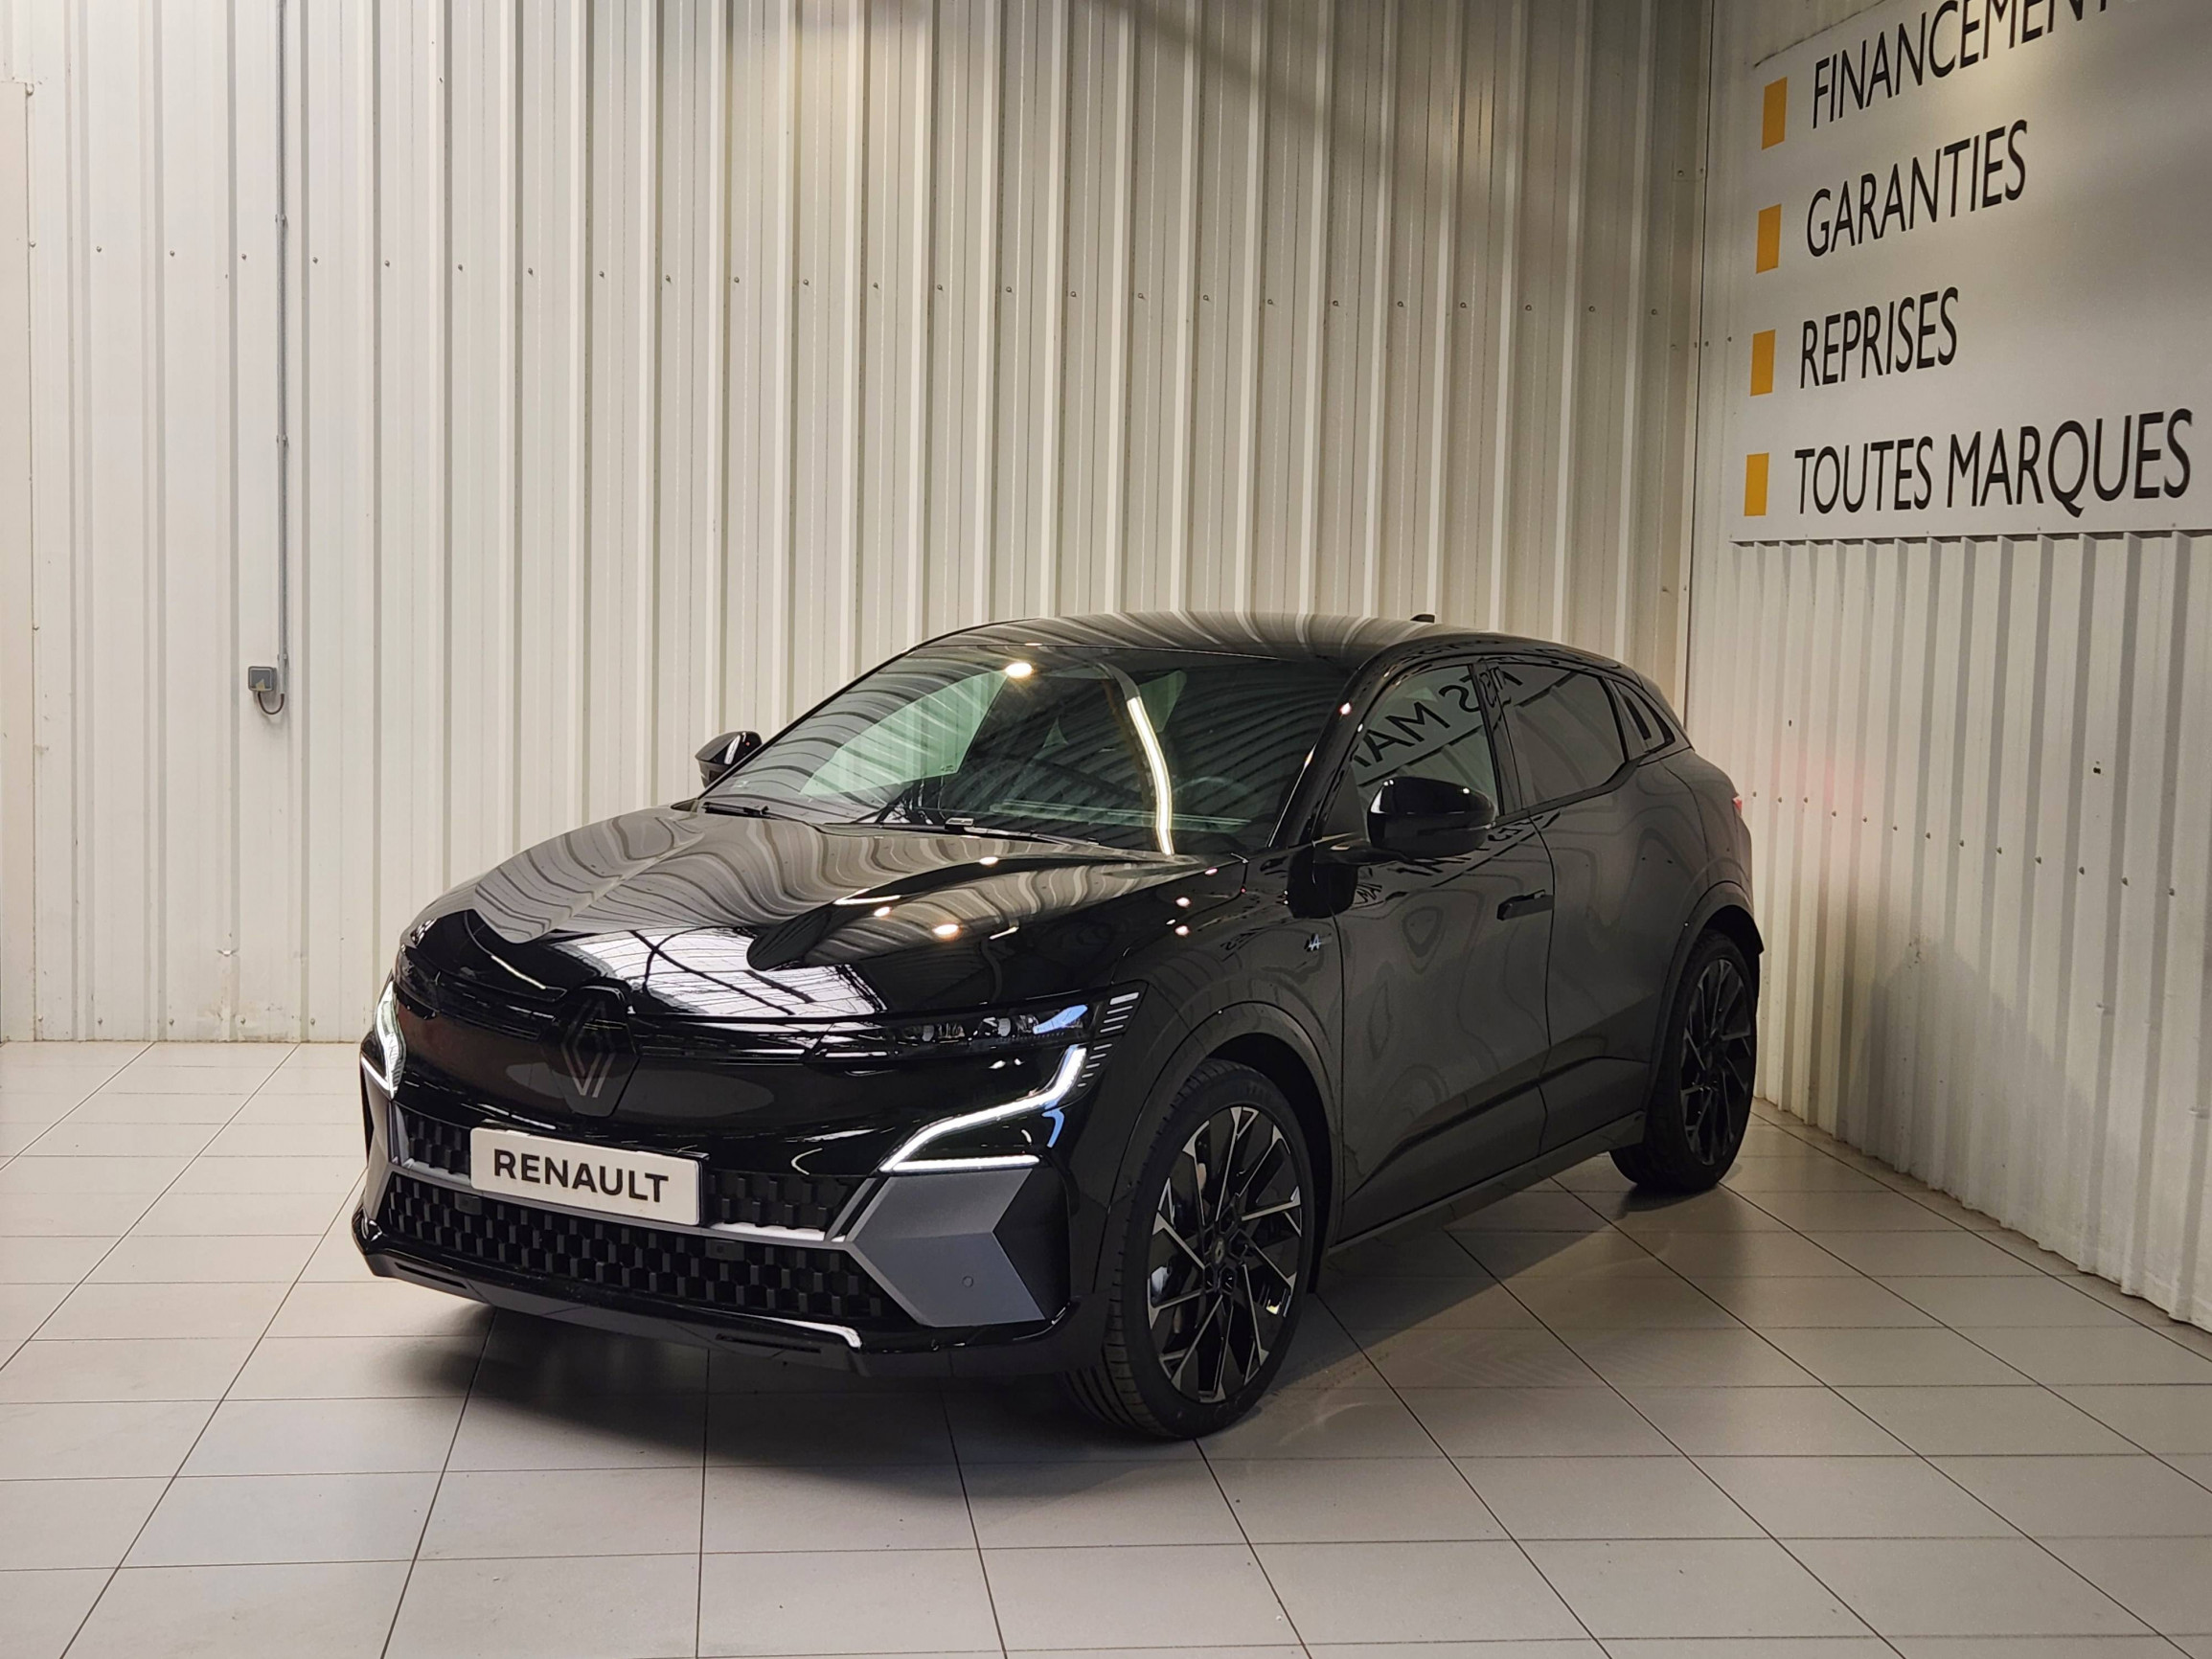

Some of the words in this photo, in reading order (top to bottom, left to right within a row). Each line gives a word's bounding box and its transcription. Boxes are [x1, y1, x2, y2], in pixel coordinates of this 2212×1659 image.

[1806, 119, 2028, 258] GARANTIES
[1799, 286, 1959, 390] REPRISES
[1793, 435, 1934, 514] TOUTES
[1946, 407, 2194, 519] MARQUES
[492, 1148, 670, 1203] RENAULT
